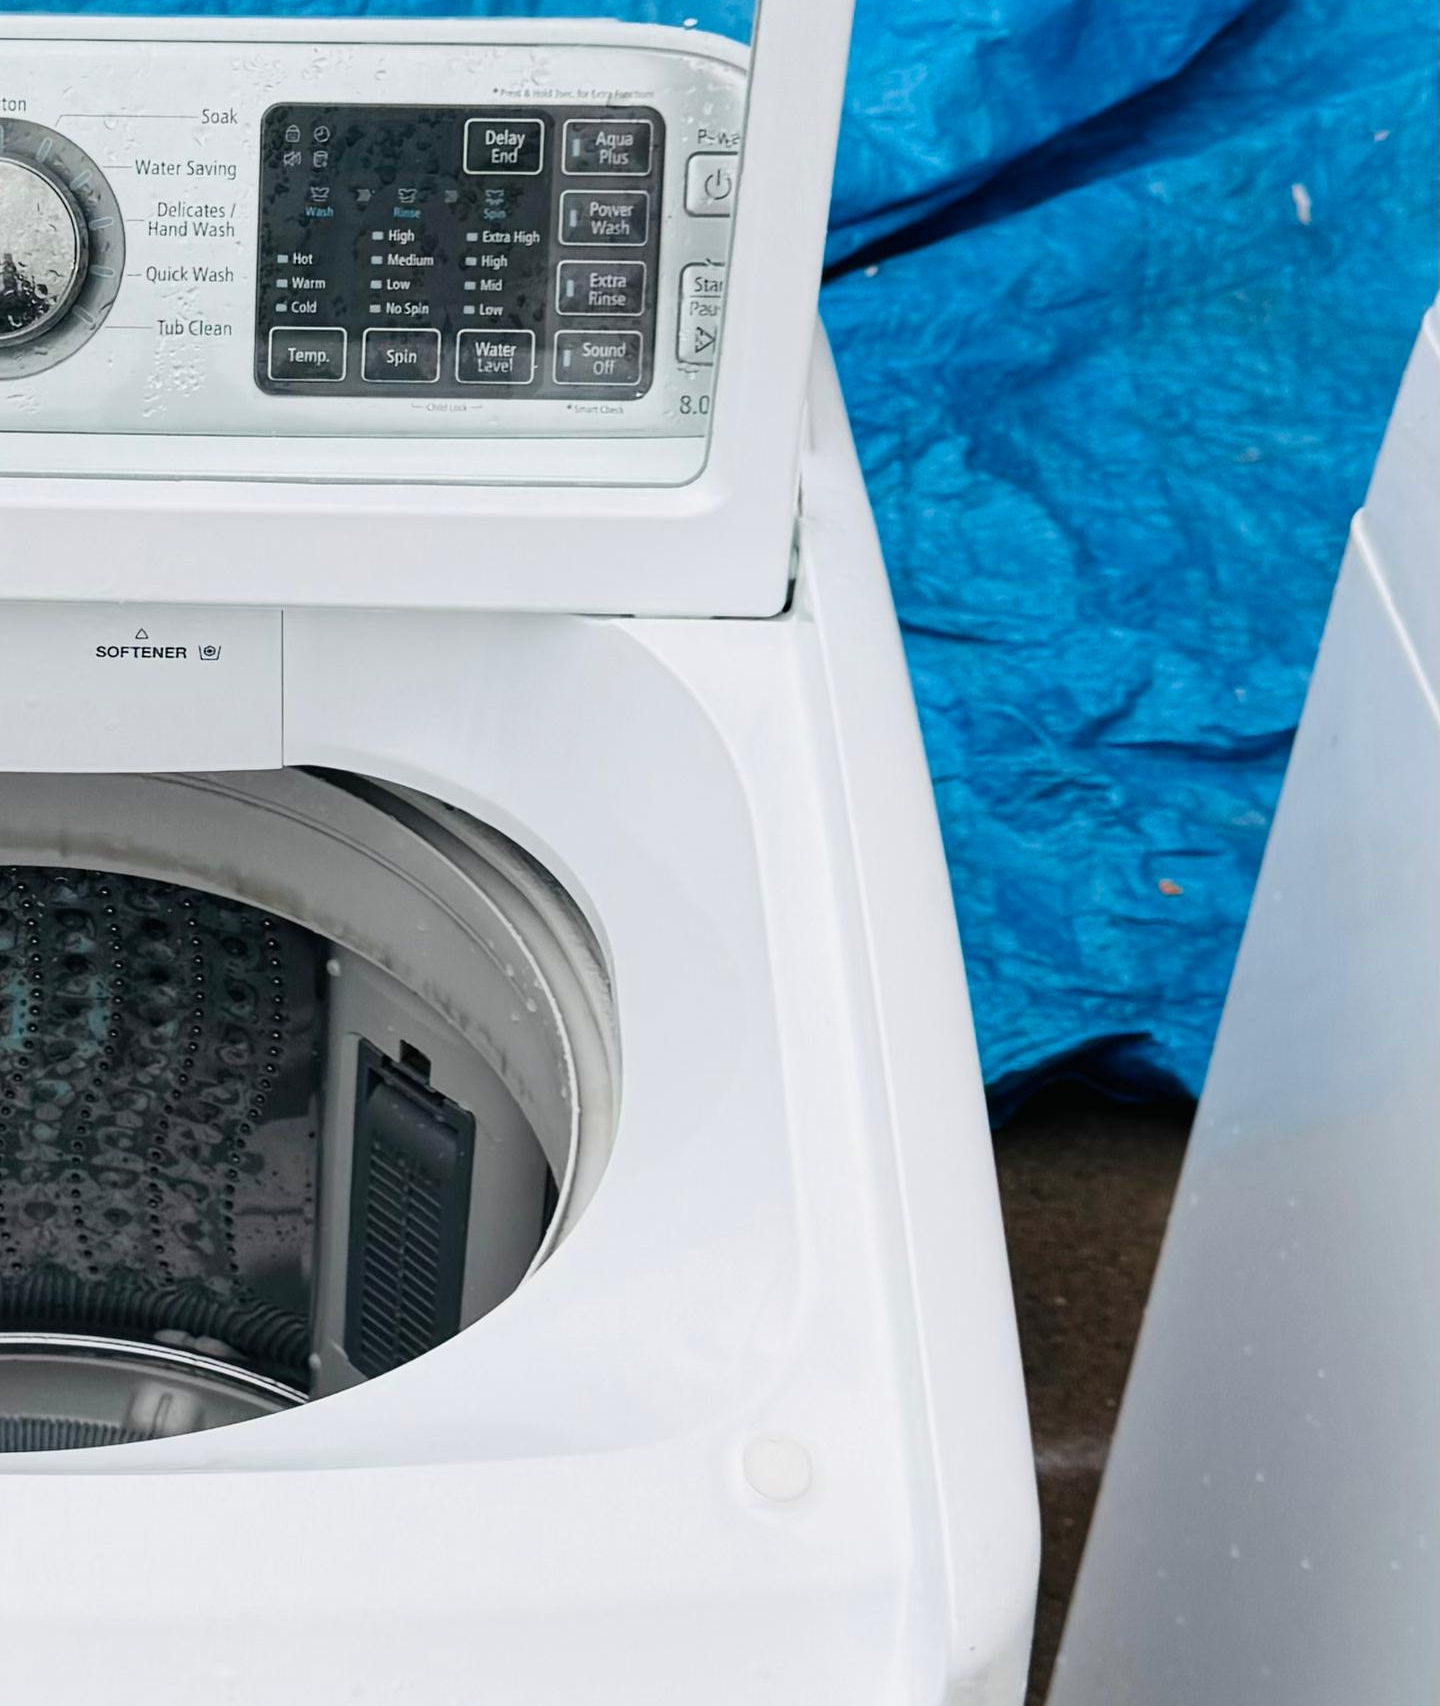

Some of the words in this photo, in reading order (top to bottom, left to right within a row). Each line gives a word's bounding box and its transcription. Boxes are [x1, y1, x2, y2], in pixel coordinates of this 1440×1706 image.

[201, 107, 238, 124] Soak
[485, 129, 525, 149] Delay
[595, 131, 634, 150] Aqua
[491, 148, 518, 163] End
[599, 150, 629, 165] Plus
[135, 159, 181, 175] Water
[186, 160, 237, 180] Saving
[157, 201, 226, 218] Delicates
[305, 206, 334, 218] Wash
[393, 207, 421, 219] Rinse
[589, 201, 634, 217] Power
[148, 221, 188, 237] Hand
[192, 221, 235, 237] Wash
[591, 221, 630, 235] Wash
[388, 229, 415, 244] High
[482, 231, 510, 243] Extra
[513, 230, 540, 246] High
[292, 253, 313, 265] Hot
[387, 254, 434, 266] Medium
[481, 255, 508, 270] High
[146, 265, 189, 284] Quick
[192, 266, 234, 282] Wash
[589, 272, 627, 288] Extra
[292, 277, 326, 289] Warm
[386, 278, 411, 290] Low
[480, 279, 503, 291] Mid
[588, 292, 626, 306] Rinse
[291, 301, 317, 313] Cold
[386, 303, 402, 314] No
[404, 302, 429, 317] Spin
[479, 304, 503, 316] Low
[157, 318, 184, 335] Tub
[188, 319, 232, 336] Clean
[288, 348, 330, 366] Temp.
[475, 342, 517, 357] Water
[582, 343, 626, 358] Sound
[386, 349, 417, 366] Spin
[477, 358, 513, 373] Level
[593, 360, 616, 376] Off
[95, 645, 188, 660] SOFTENER
